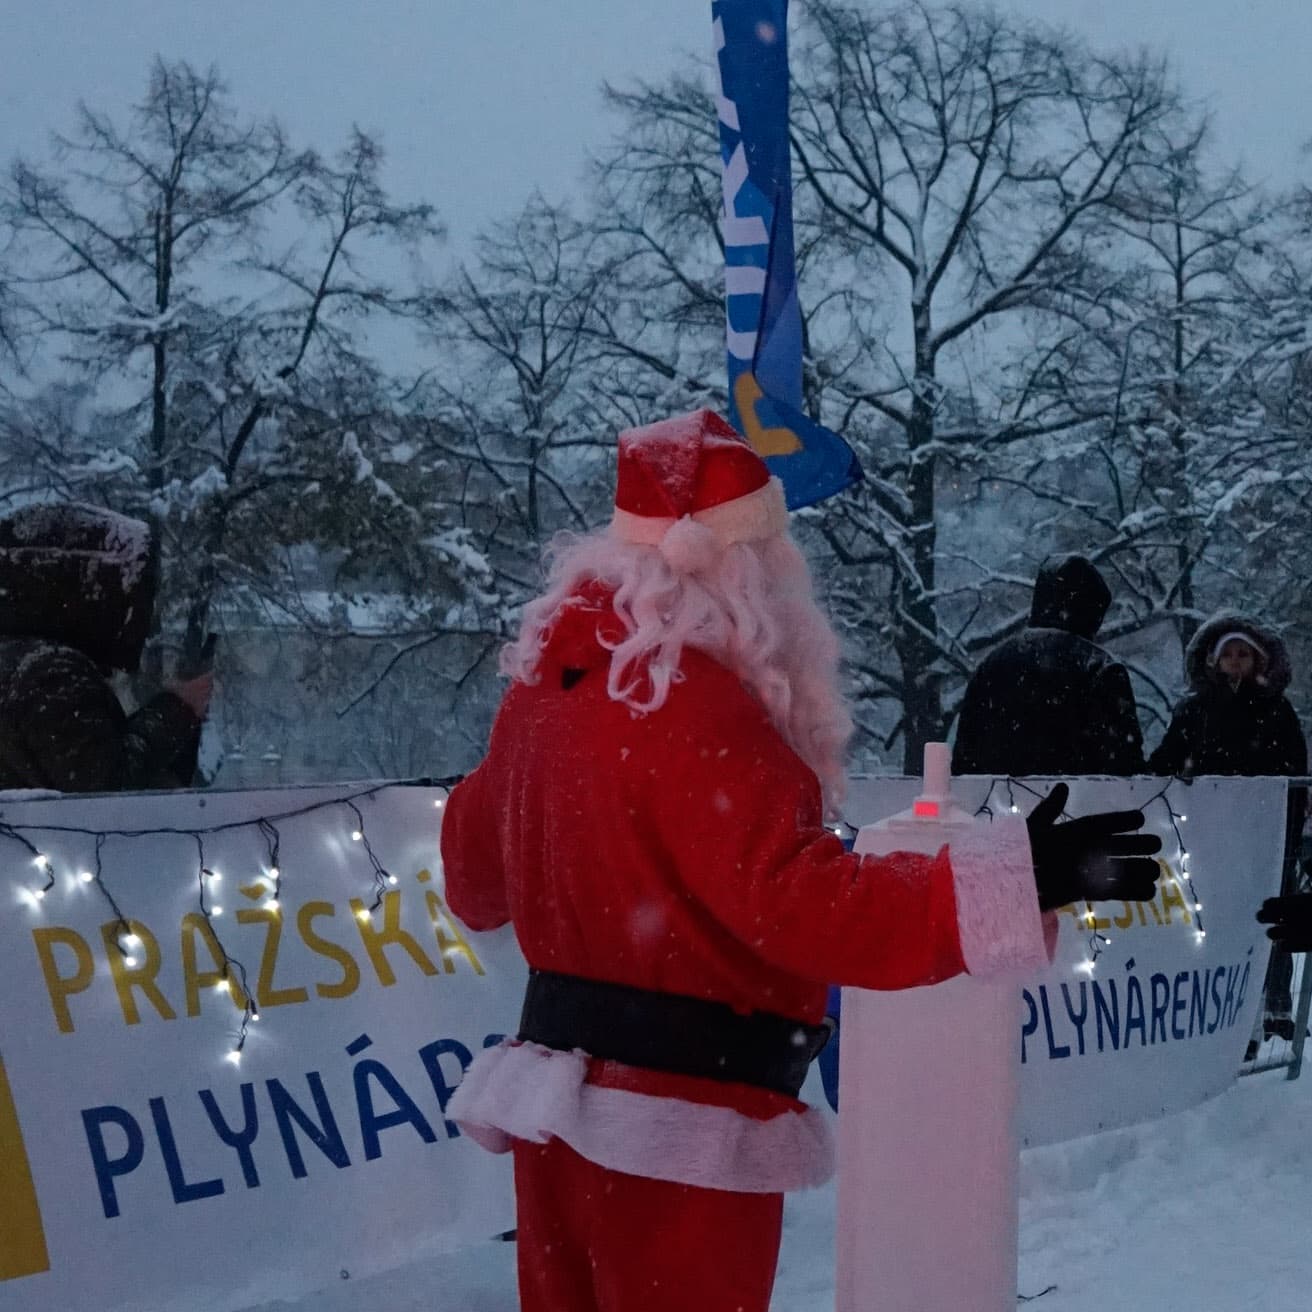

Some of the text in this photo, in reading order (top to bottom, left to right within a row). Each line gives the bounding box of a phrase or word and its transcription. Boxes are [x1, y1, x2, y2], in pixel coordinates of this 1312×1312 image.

[33, 870, 486, 1034] PRAŽSKÁ
[1021, 945, 1254, 1064] PLYNÁRENSKÁ
[80, 1032, 507, 1219] PLYNÁR
